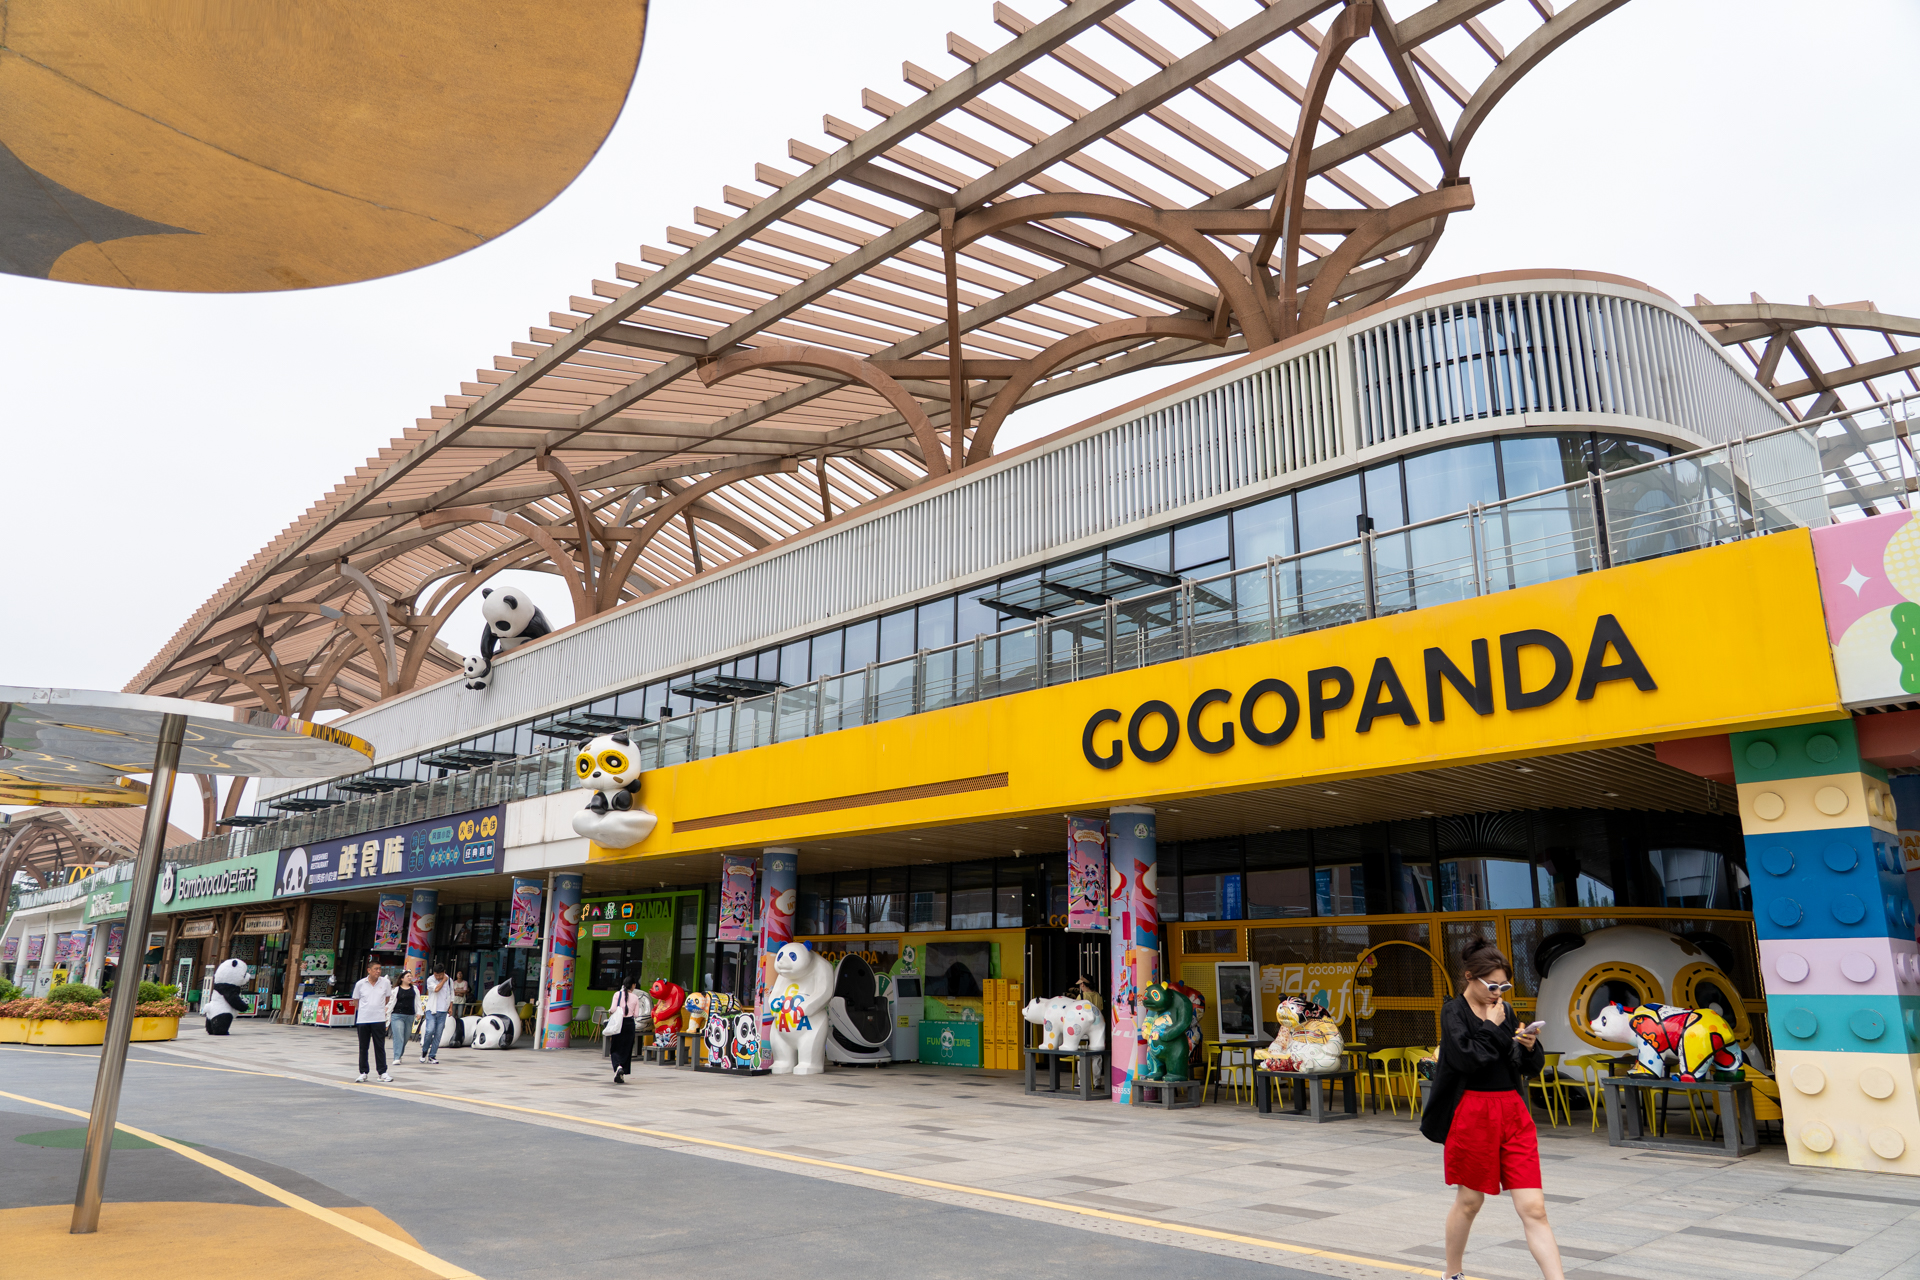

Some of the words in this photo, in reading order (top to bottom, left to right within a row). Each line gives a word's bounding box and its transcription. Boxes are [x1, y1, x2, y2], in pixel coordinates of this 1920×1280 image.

[1082, 613, 1658, 770] GOGOPANDA
[337, 835, 405, 880] 鲜食味
[177, 869, 230, 900] Bamboocub
[634, 900, 671, 919] PANDA
[1308, 966, 1336, 975] GOGO
[926, 1036, 941, 1046] FUN
[953, 1038, 971, 1047] TIME
